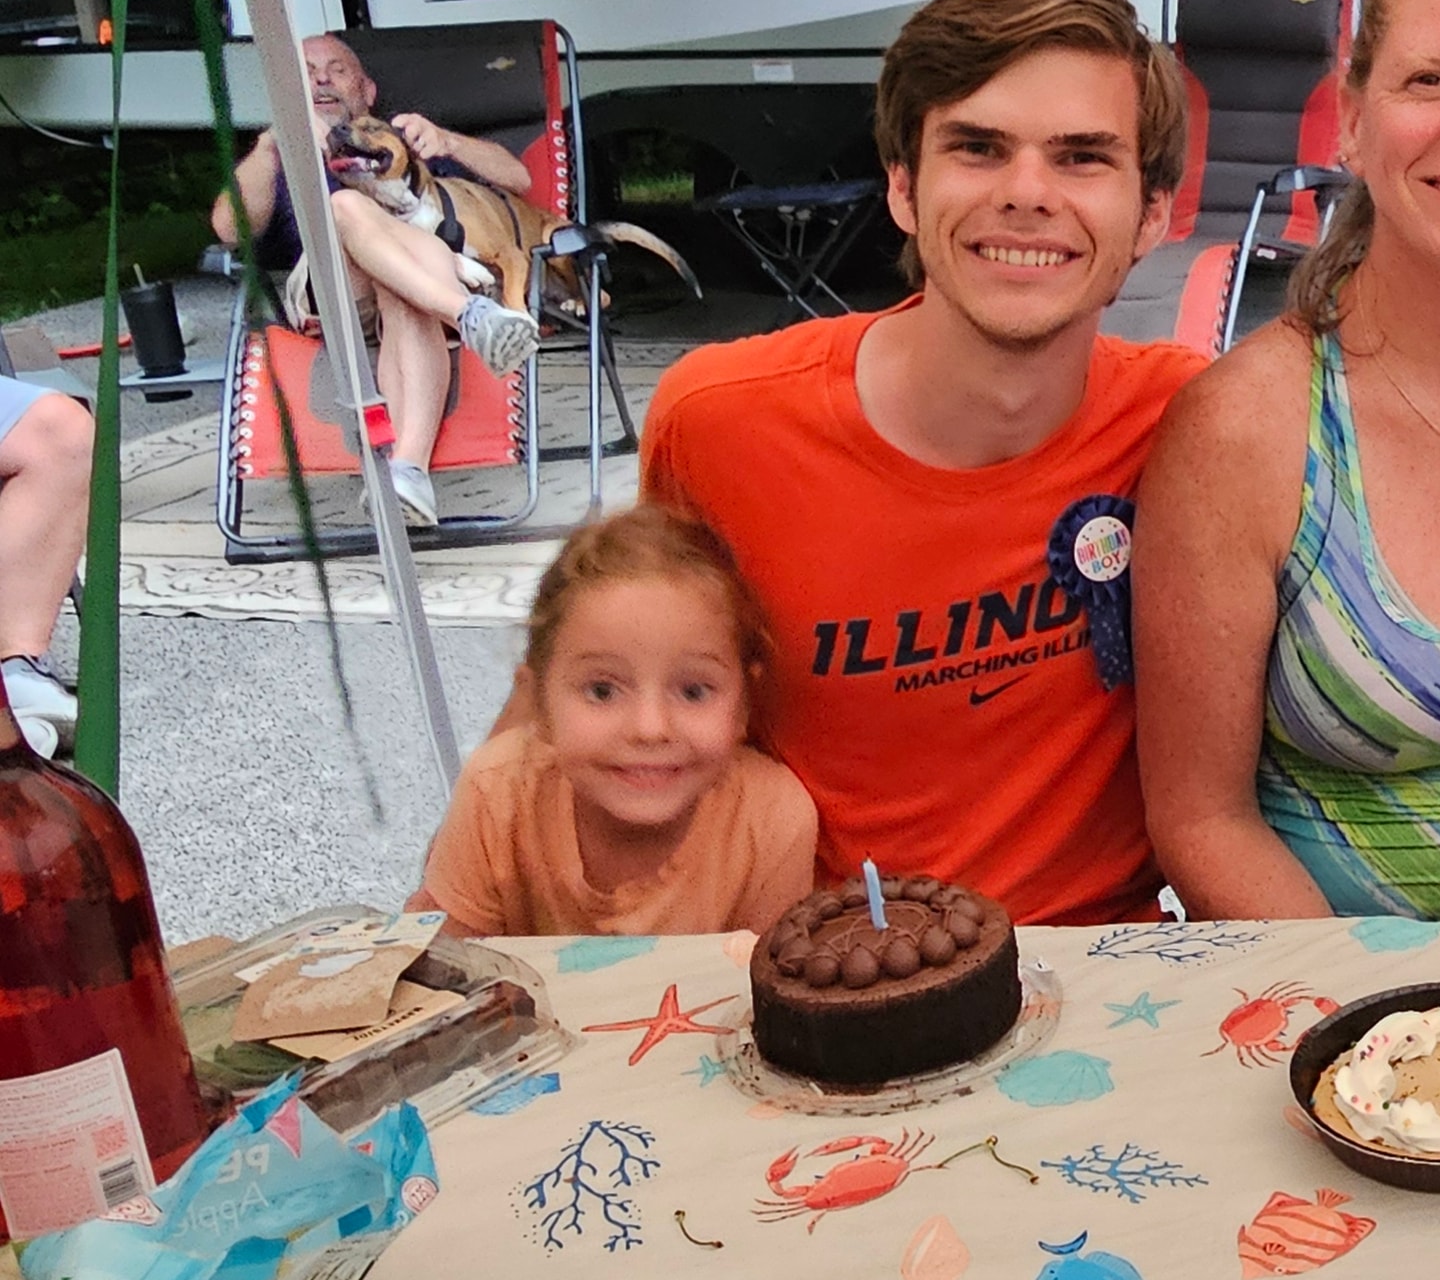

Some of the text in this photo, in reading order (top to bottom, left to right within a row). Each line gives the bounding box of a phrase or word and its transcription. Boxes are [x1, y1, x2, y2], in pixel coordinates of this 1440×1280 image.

[1077, 527, 1129, 566] BIRTHDAY
[1091, 549, 1121, 574] BOY
[894, 645, 1039, 693] MARCHING
